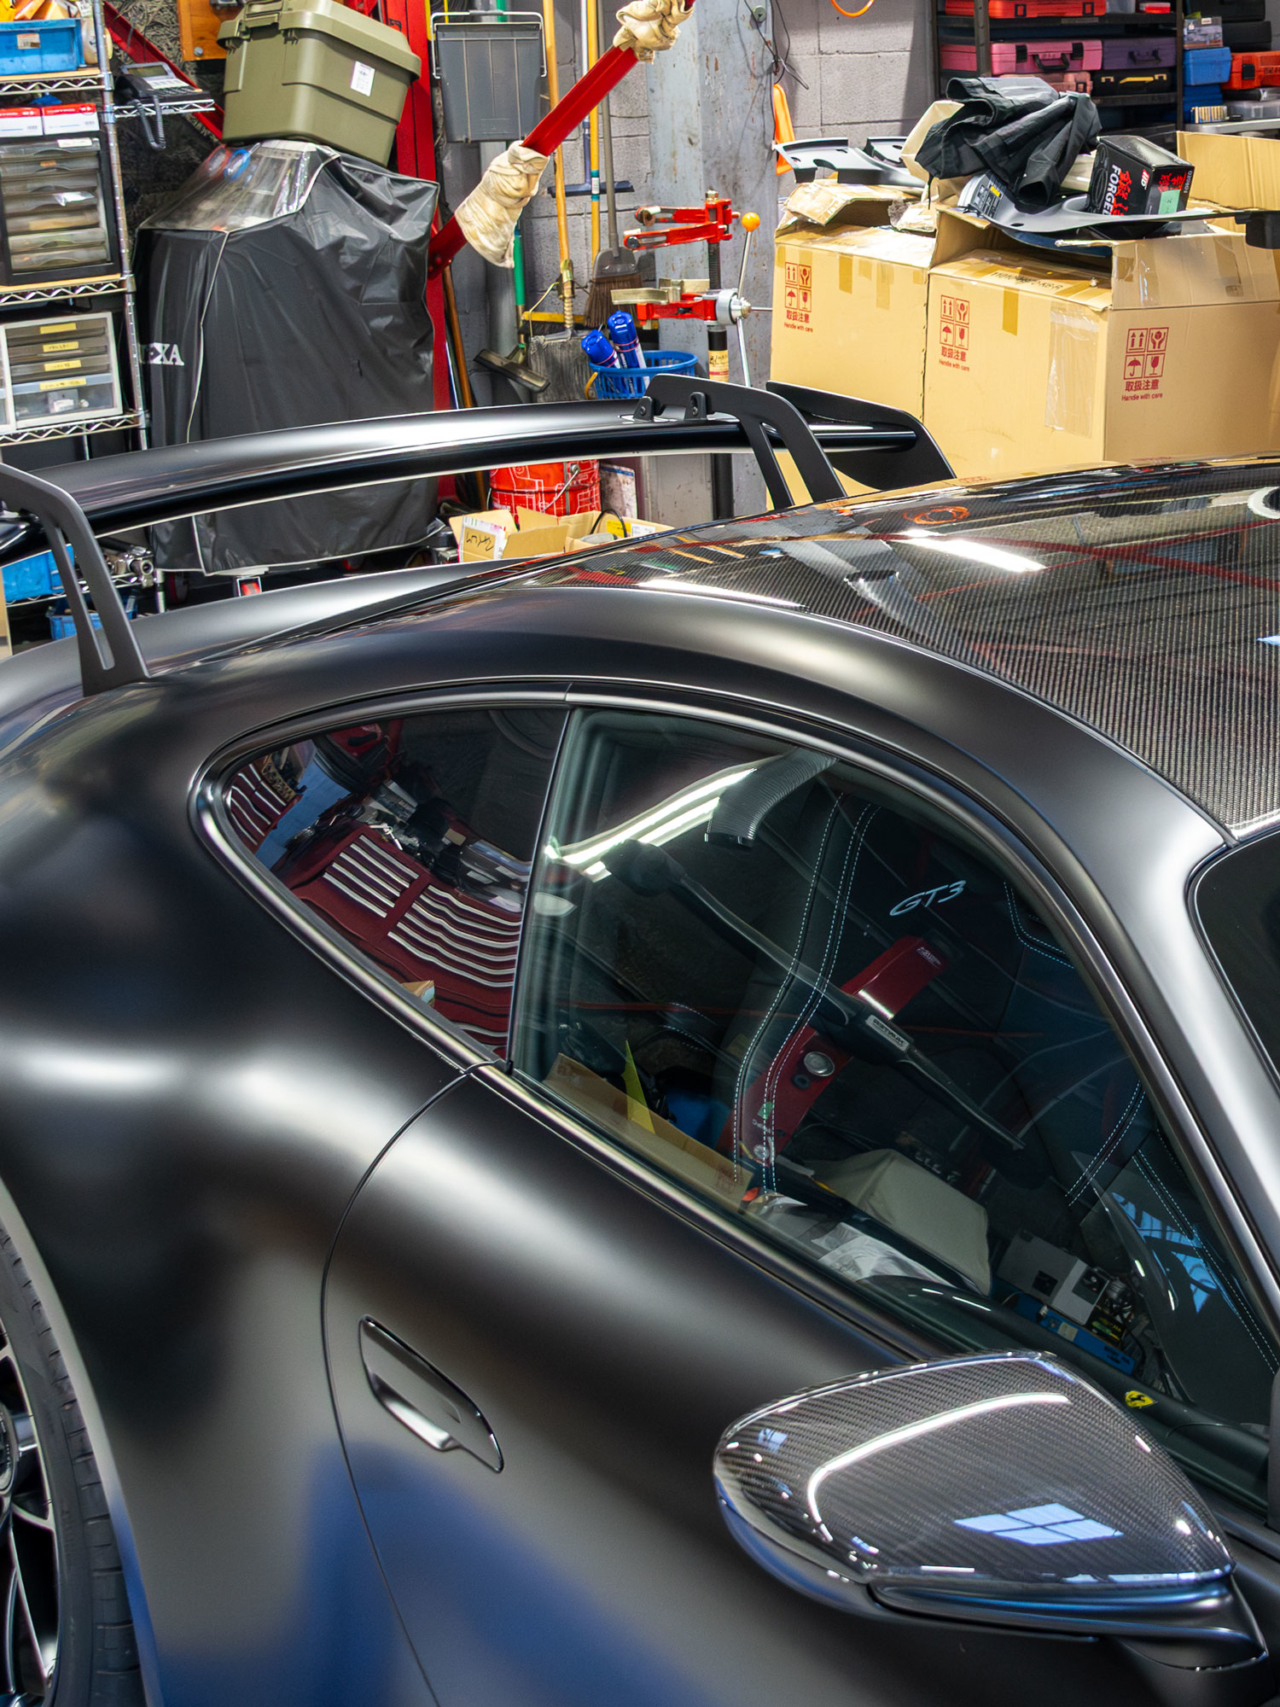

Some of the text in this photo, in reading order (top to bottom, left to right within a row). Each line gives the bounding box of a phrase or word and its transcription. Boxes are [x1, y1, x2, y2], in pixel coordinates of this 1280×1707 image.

[1125, 379, 1159, 391] 取扱注意
[889, 879, 967, 916] GT3
